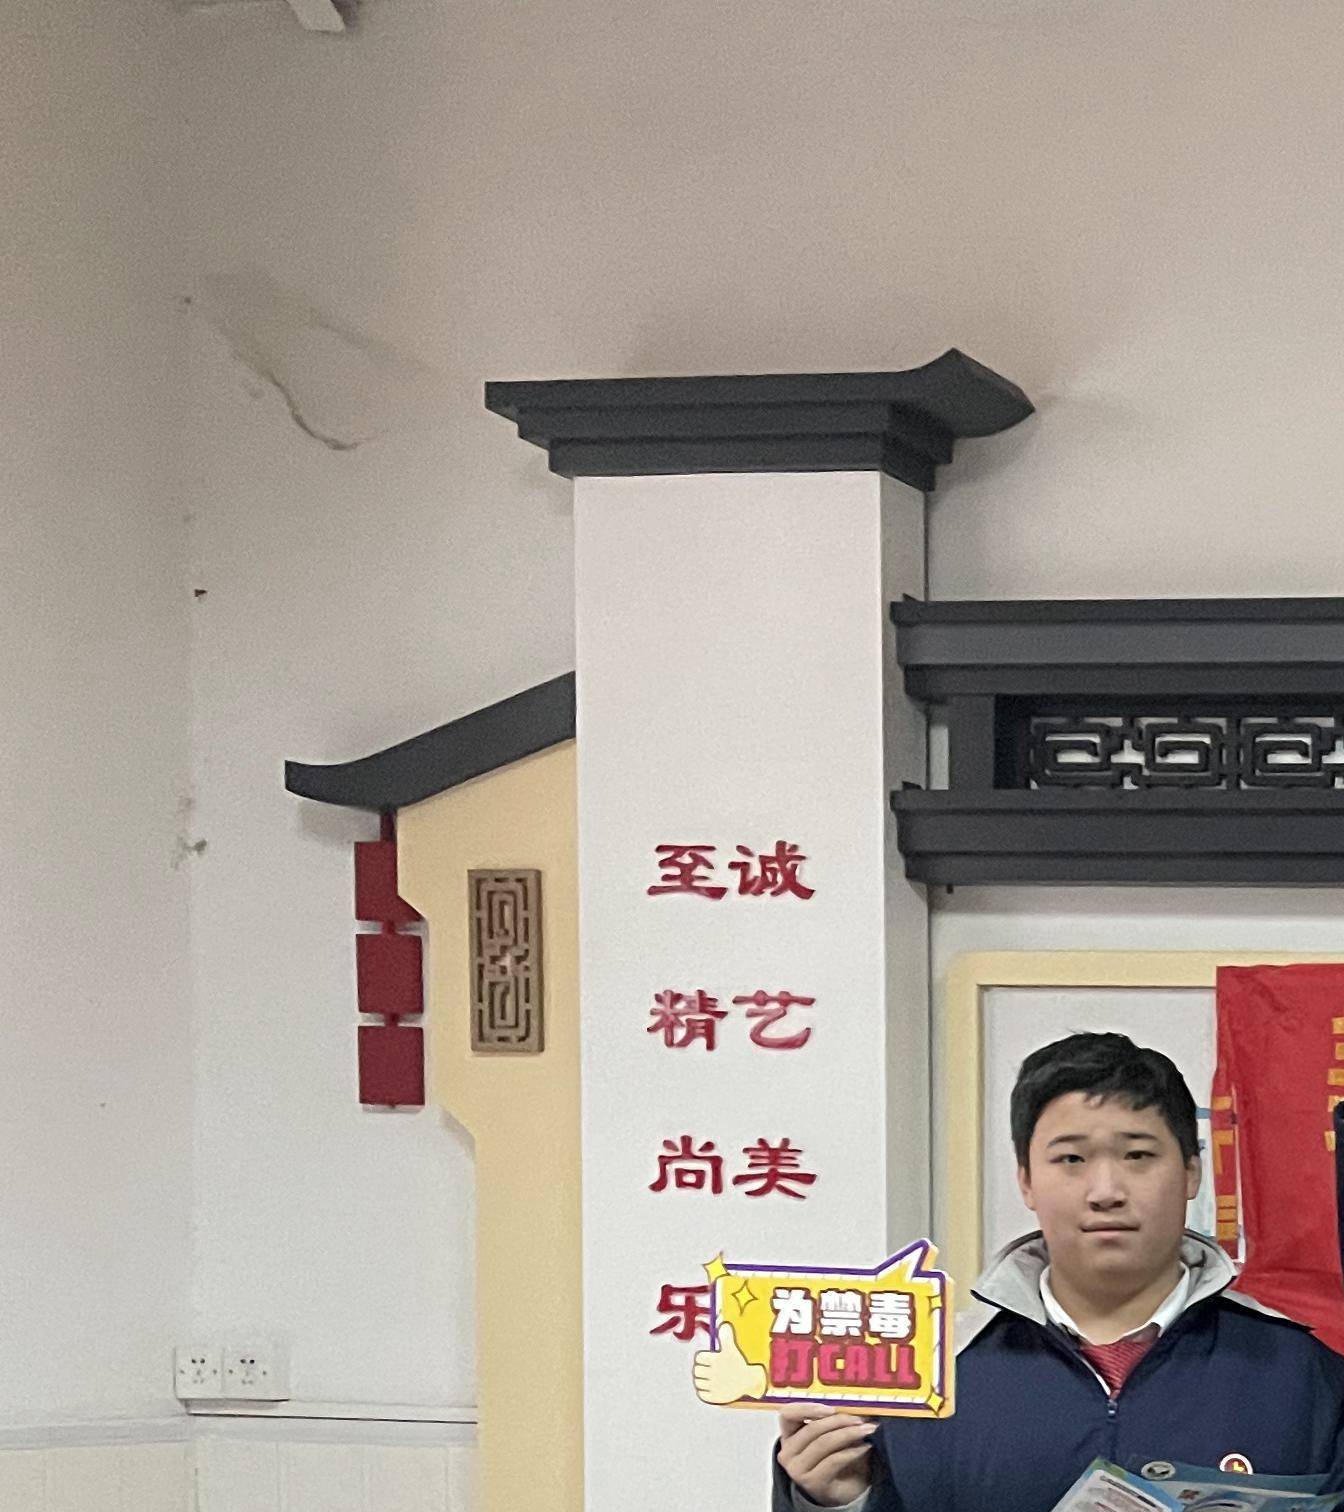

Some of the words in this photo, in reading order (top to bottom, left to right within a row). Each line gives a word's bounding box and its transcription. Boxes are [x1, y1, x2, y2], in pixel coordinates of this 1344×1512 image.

[647, 840, 815, 900] 至诚
[647, 989, 816, 1051] 精艺
[649, 1135, 817, 1199] 尚美
[771, 1287, 916, 1338] 为禁毒
[769, 1340, 921, 1389] 打CALL
